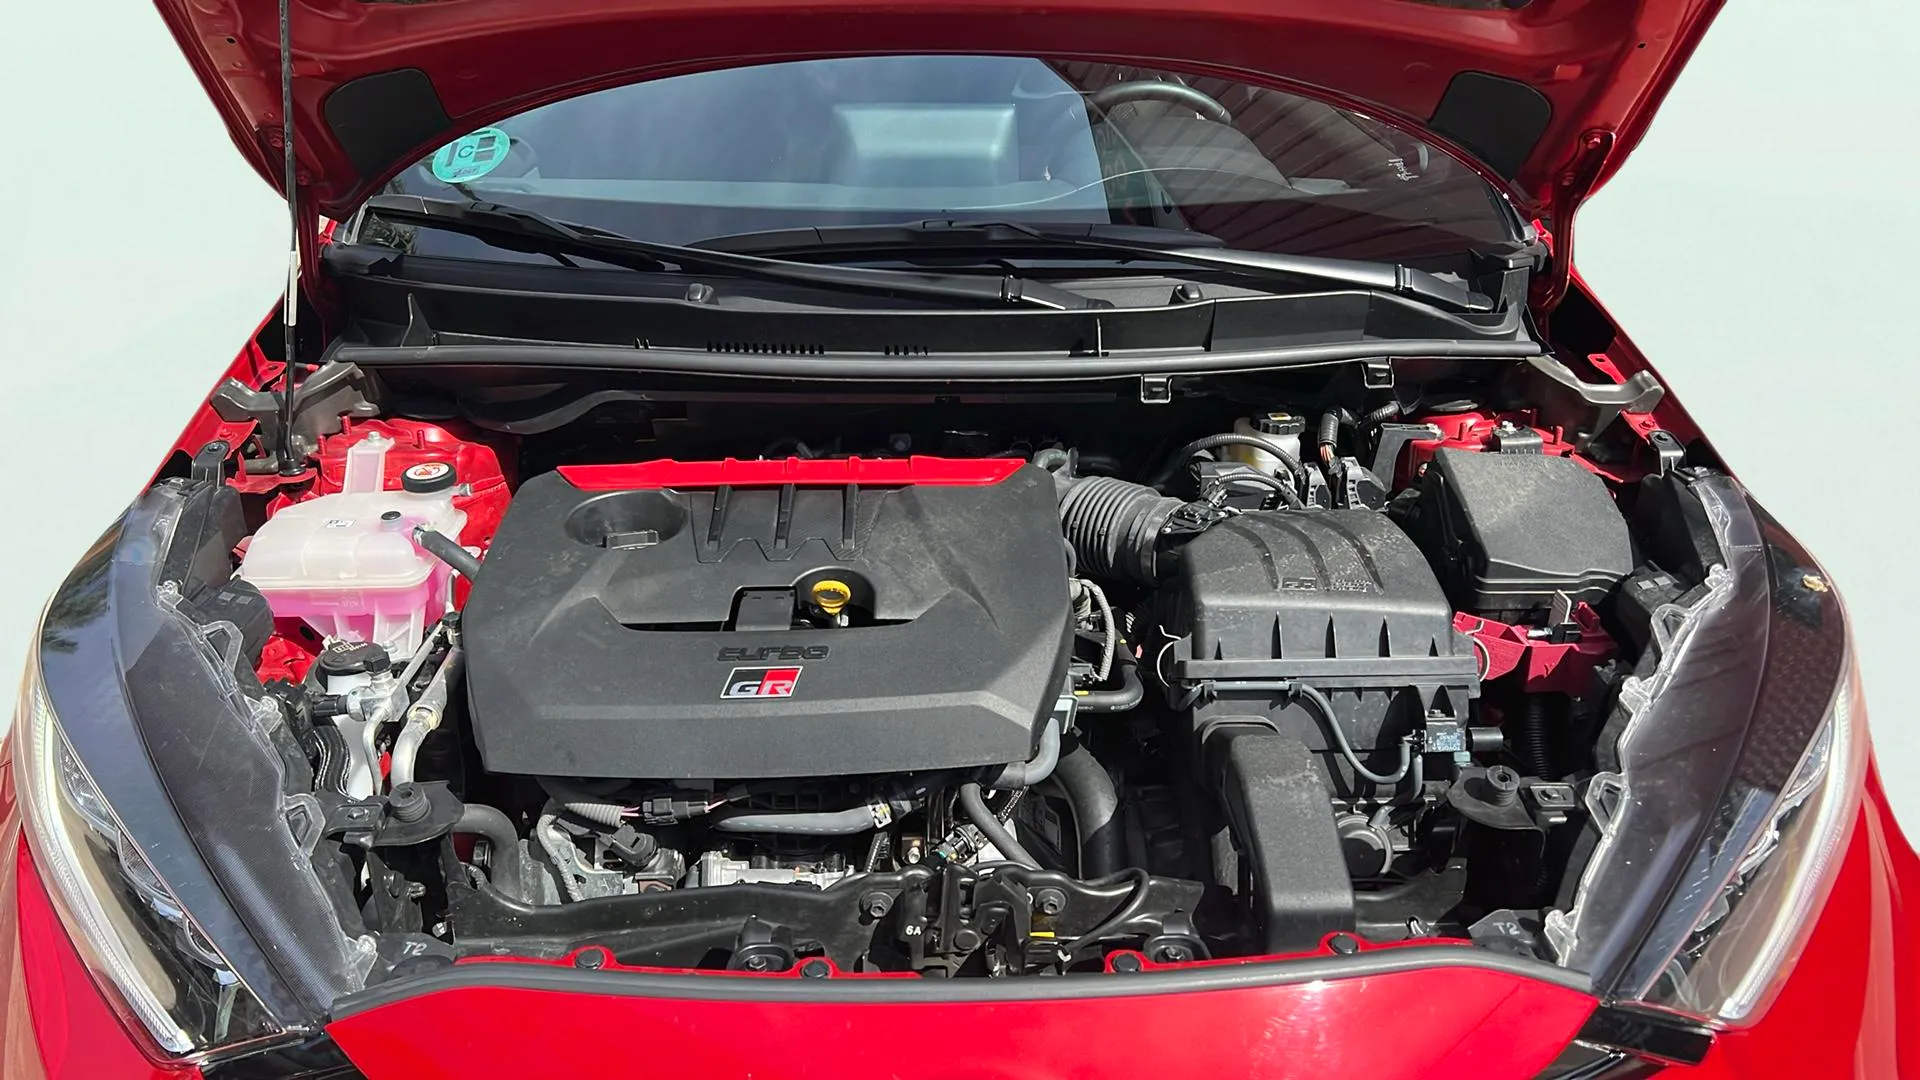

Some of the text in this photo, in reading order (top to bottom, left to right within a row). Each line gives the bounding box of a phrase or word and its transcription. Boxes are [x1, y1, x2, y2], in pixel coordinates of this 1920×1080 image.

[729, 680, 795, 696] GR
[905, 924, 922, 936] 6A
[1492, 921, 1521, 936] T2
[403, 941, 428, 956] T2
